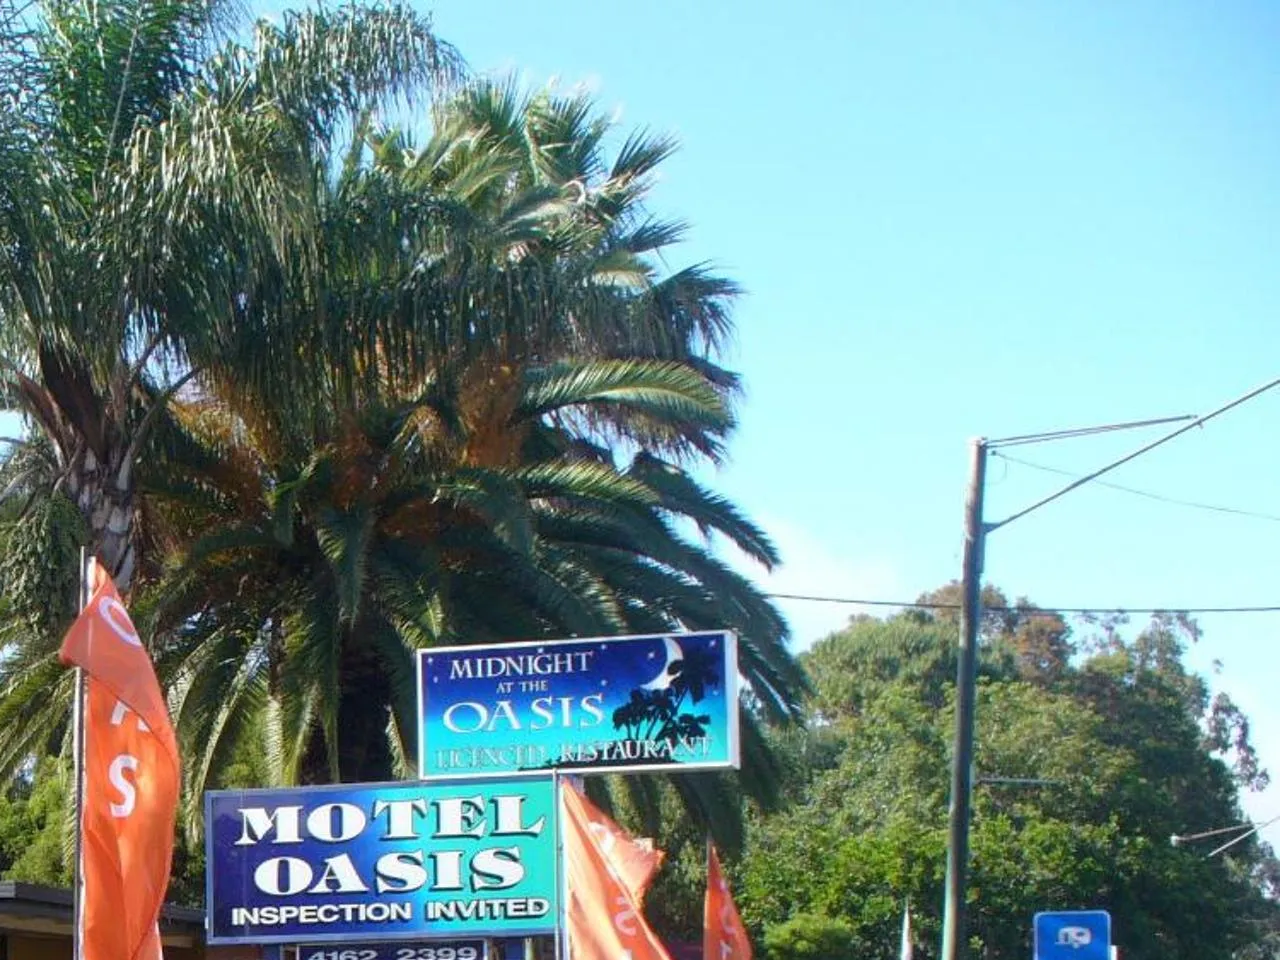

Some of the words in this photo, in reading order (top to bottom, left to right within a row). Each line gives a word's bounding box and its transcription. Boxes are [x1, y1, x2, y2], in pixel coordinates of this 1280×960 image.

[450, 650, 594, 680] MIDNIGHT
[496, 682, 514, 694] AT
[519, 680, 548, 693] THE
[442, 692, 606, 734] OASIS
[560, 735, 714, 763] RESTAURANT
[234, 795, 546, 846] MOTEL
[253, 846, 526, 896] OASIS
[231, 902, 413, 926] INSPECTION
[427, 898, 551, 921] INVITED
